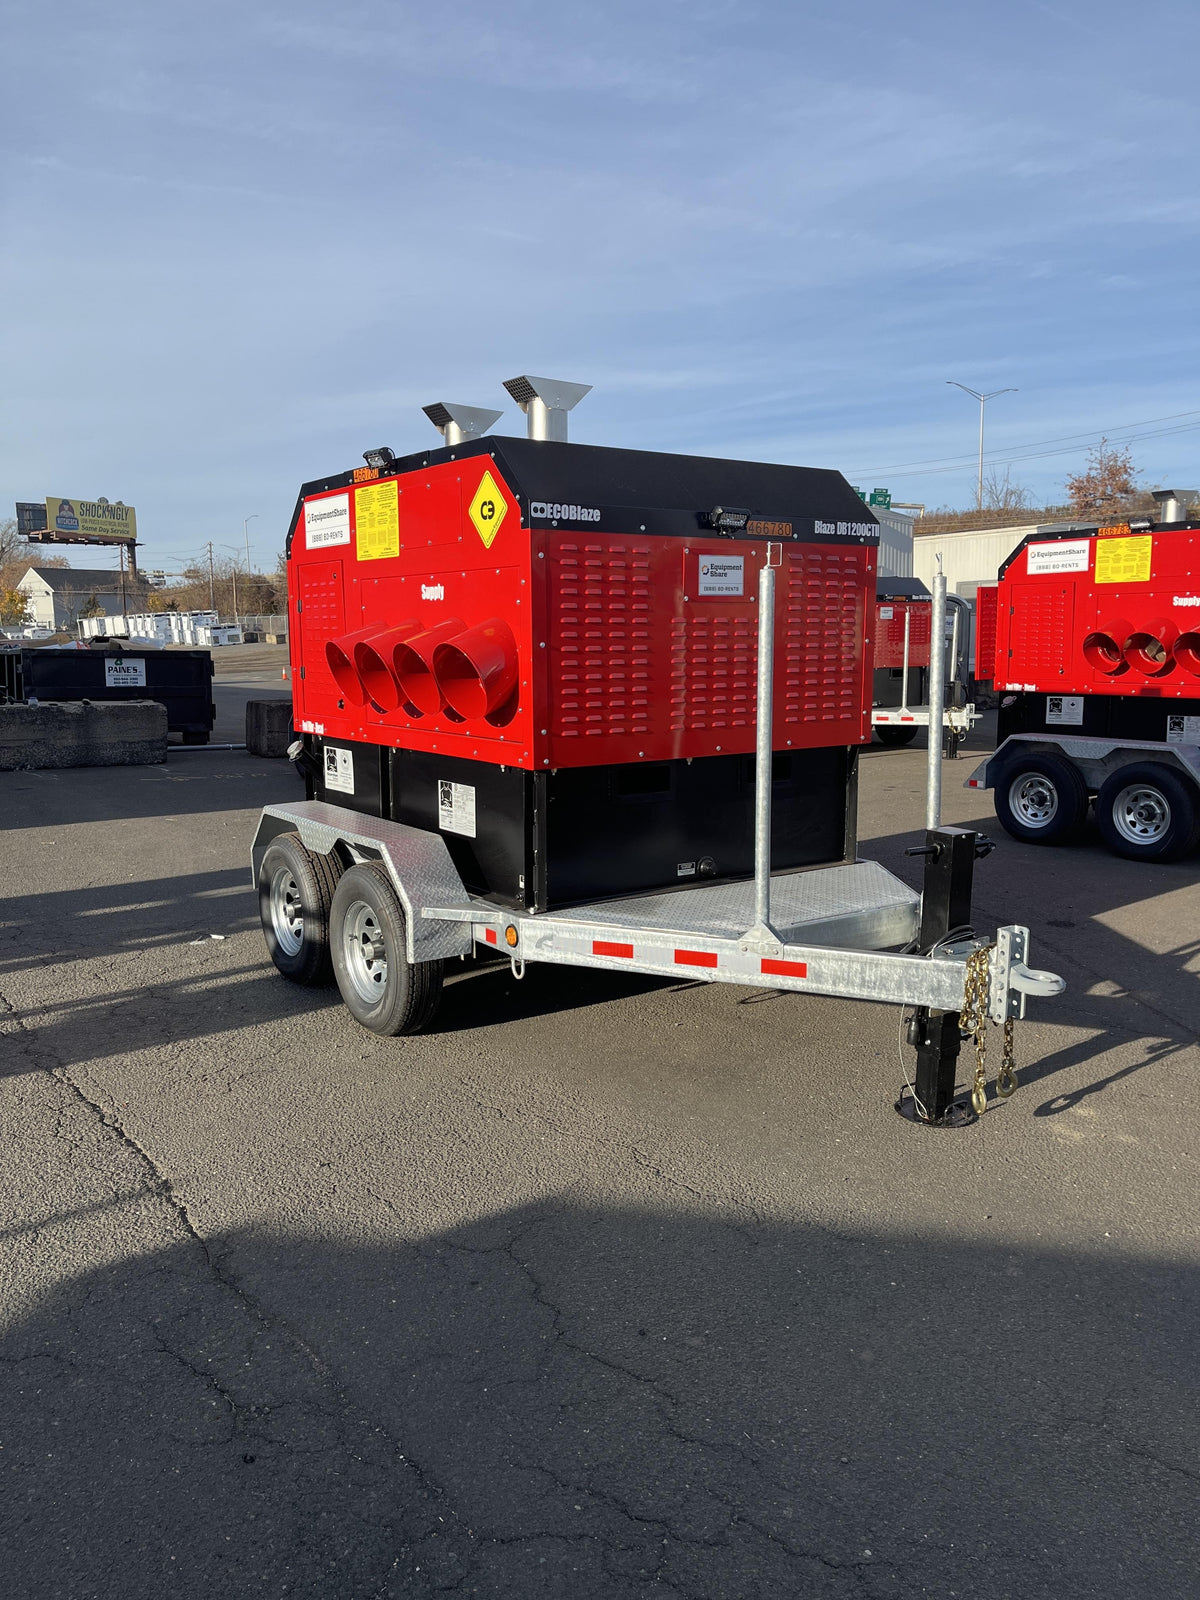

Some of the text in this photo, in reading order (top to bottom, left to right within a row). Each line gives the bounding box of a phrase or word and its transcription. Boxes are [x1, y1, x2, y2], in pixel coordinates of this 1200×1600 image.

[547, 503, 601, 522] ECOBlaze
[749, 521, 792, 536] 466780
[814, 520, 836, 535] Blaze
[1037, 549, 1086, 558] EquipmentShare
[710, 563, 742, 573] Equipment
[421, 583, 444, 601] Supply
